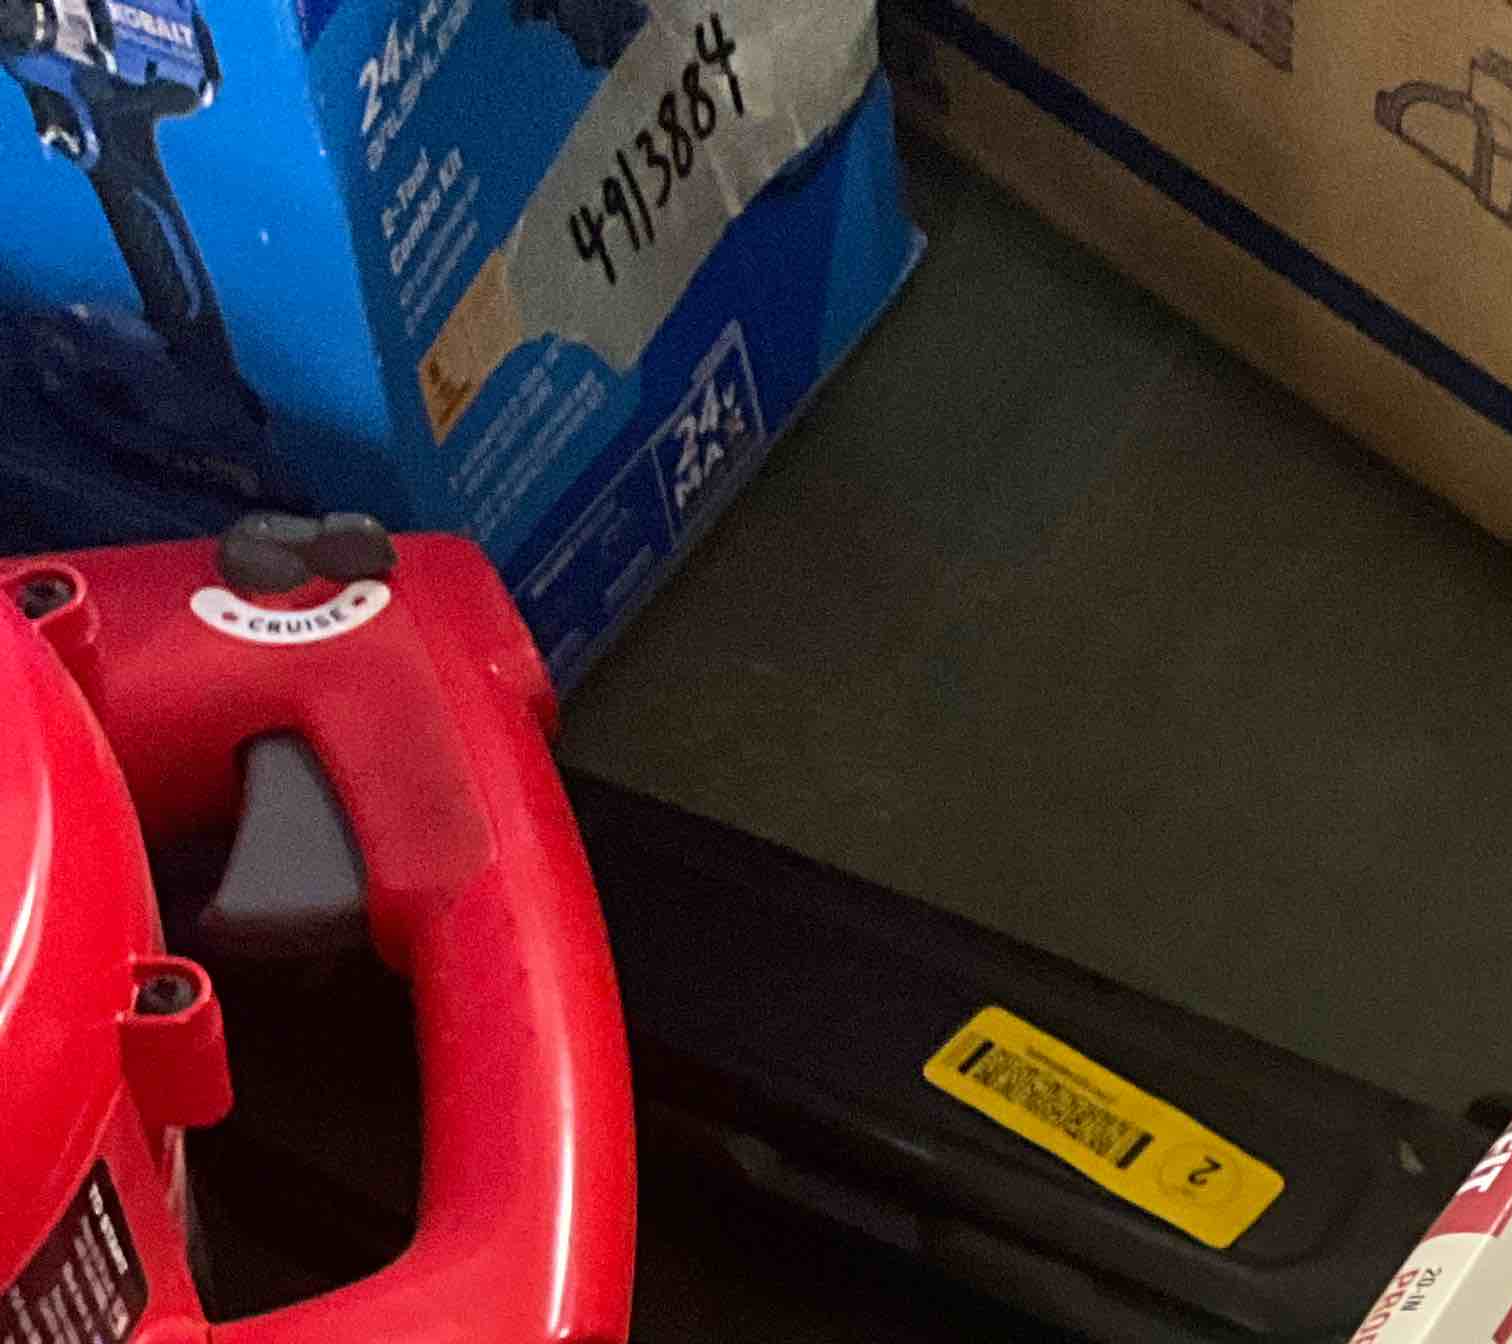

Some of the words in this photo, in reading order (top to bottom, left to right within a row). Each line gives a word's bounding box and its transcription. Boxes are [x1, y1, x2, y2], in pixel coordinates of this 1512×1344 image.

[568, 12, 746, 284] 4913884
[246, 603, 346, 637] CRUISE
[1187, 1154, 1221, 1184] 2
